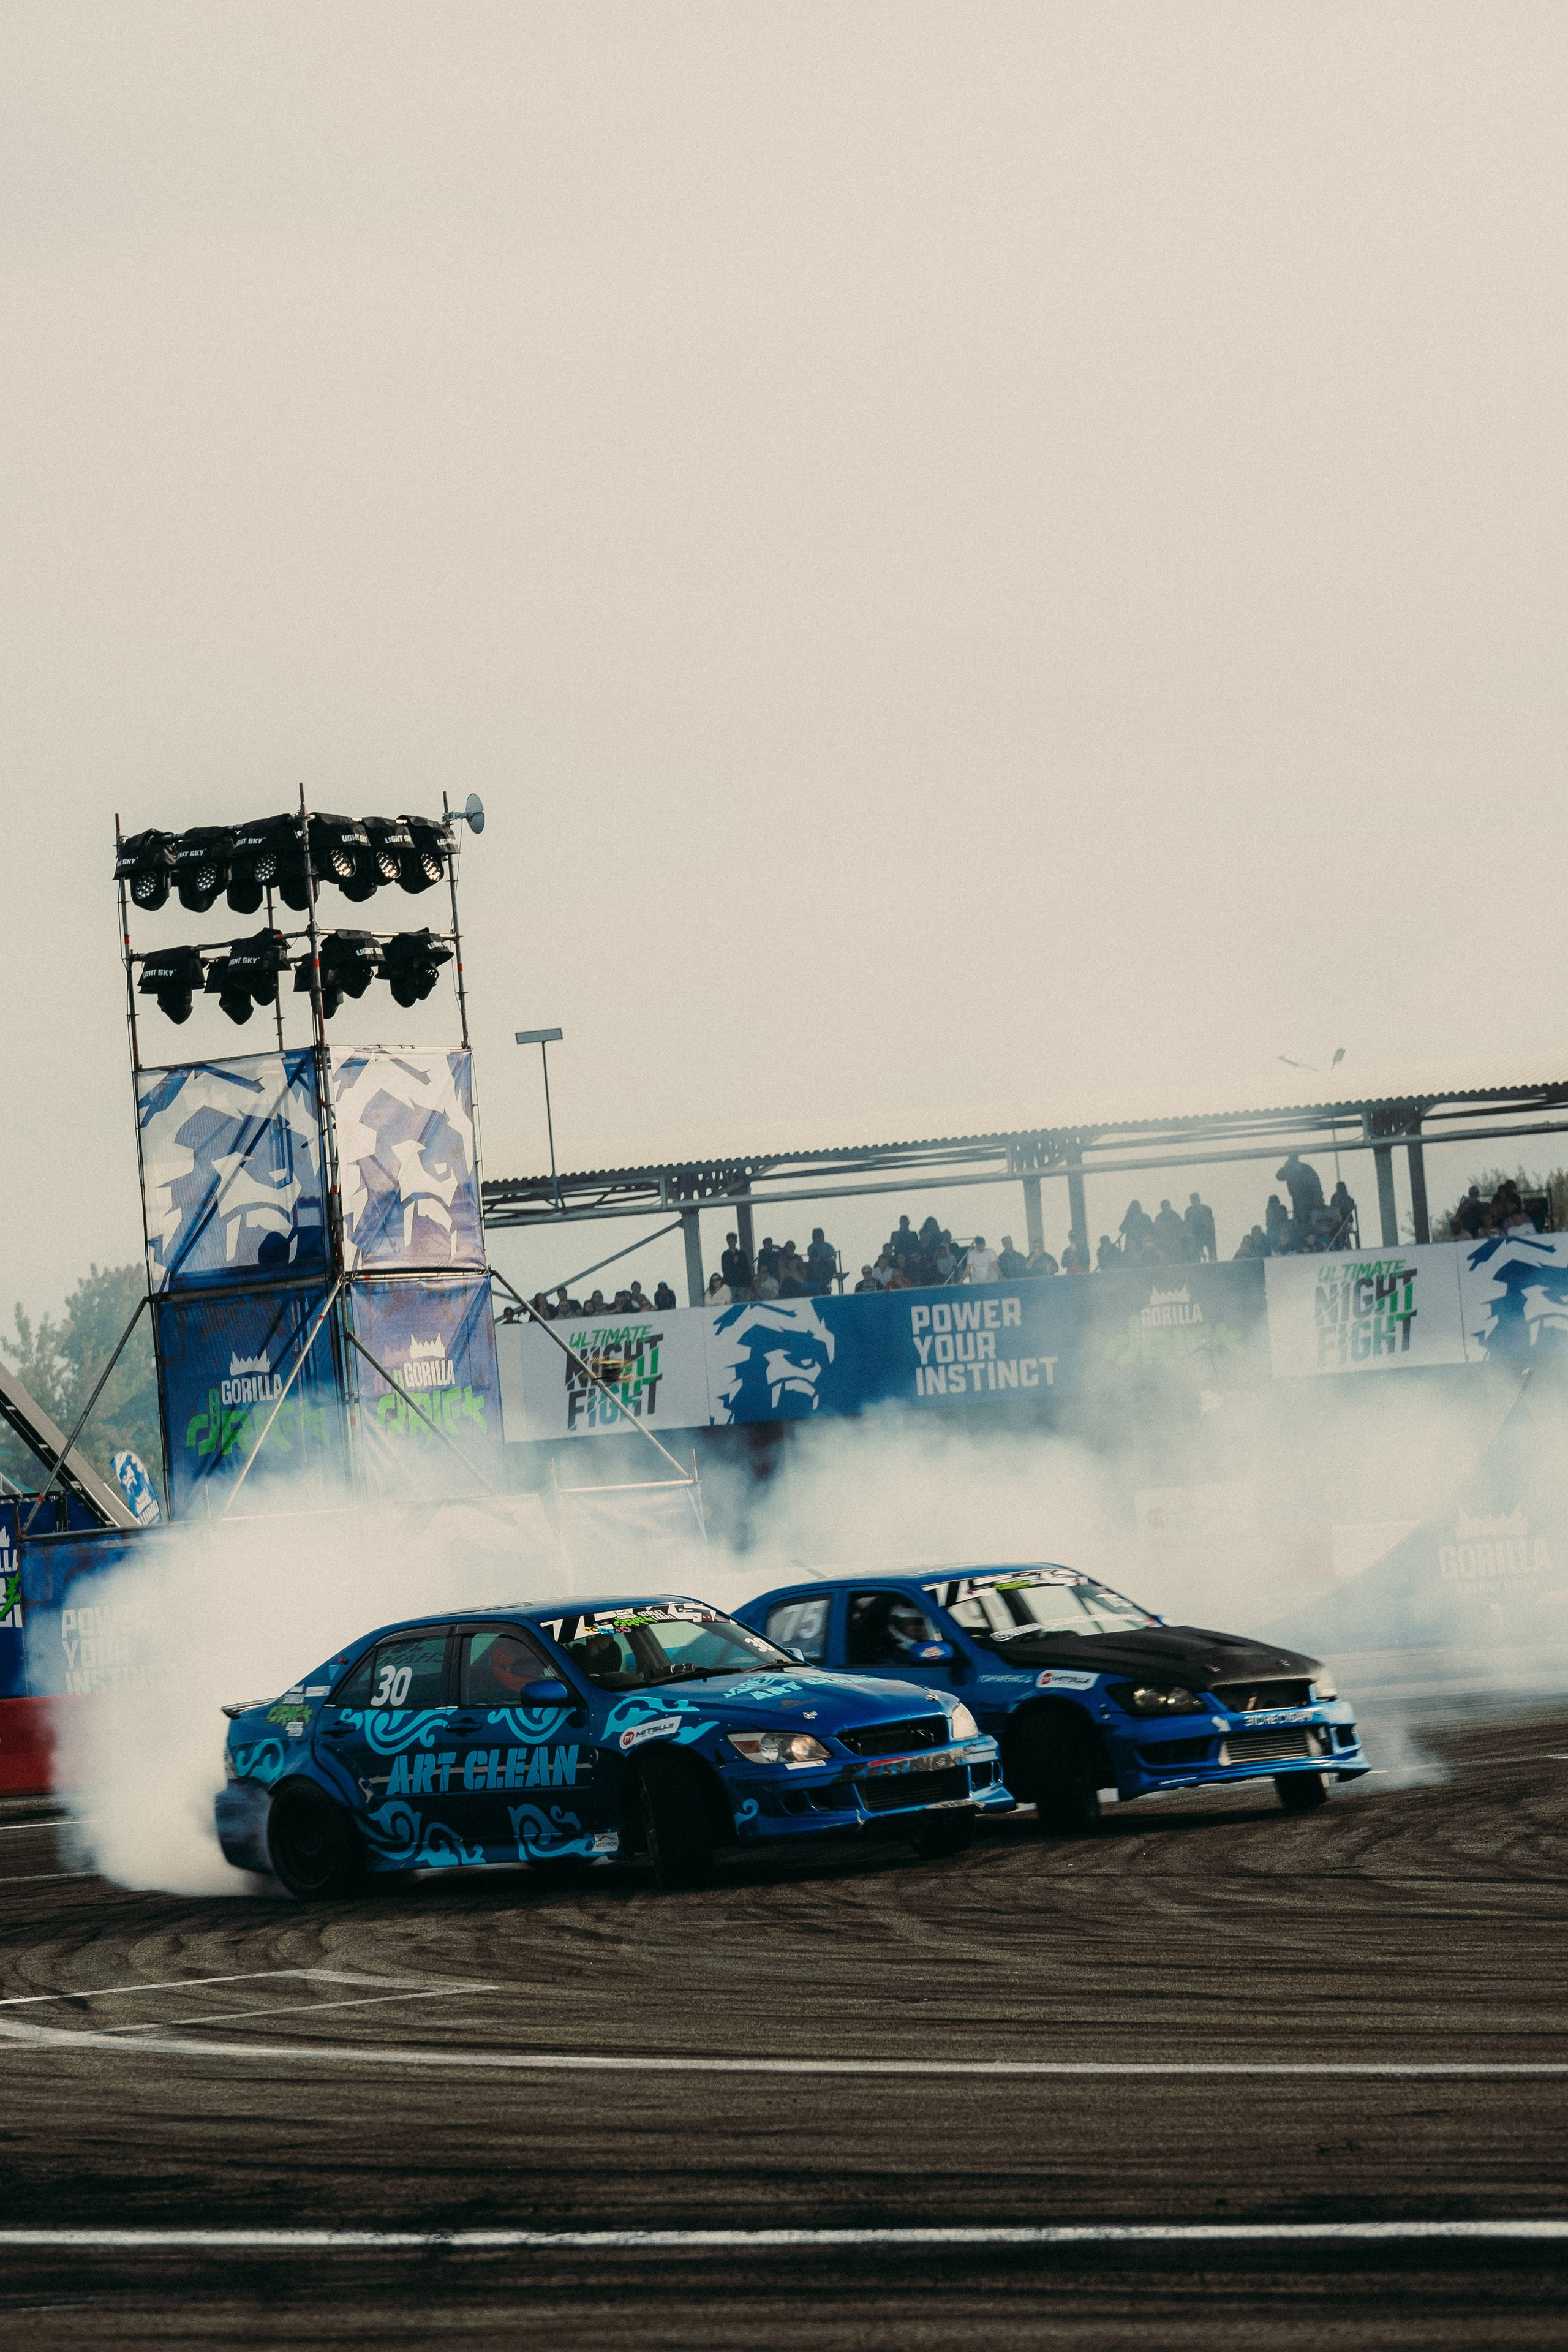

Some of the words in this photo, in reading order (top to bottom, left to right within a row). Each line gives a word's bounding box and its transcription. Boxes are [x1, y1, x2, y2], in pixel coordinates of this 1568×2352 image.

[385, 835, 403, 844] LIGHT
[356, 947, 374, 956] LIGHT
[157, 968, 174, 977] SKY
[1317, 1259, 1407, 1283] ULTIMATE
[1314, 1268, 1418, 1326] NIGHT
[910, 1297, 1022, 1336] POWER
[1140, 1302, 1205, 1328] GORILLA
[569, 1324, 653, 1349] ULTIMATE
[912, 1330, 997, 1365] YOUR
[1317, 1309, 1418, 1368] FIGHT
[221, 1374, 284, 1405] GORILLA
[404, 1359, 456, 1388] GORILLA
[915, 1355, 1059, 1397] INSTINCT
[567, 1373, 663, 1431] FIGHT
[1438, 1538, 1553, 1580] GORILLA
[782, 1600, 828, 1643] 75
[744, 1637, 775, 1653] 30
[370, 1665, 413, 1706] 30
[750, 1681, 803, 1700] ART
[386, 1751, 457, 1796] ART
[464, 1744, 579, 1790] CLEAN
